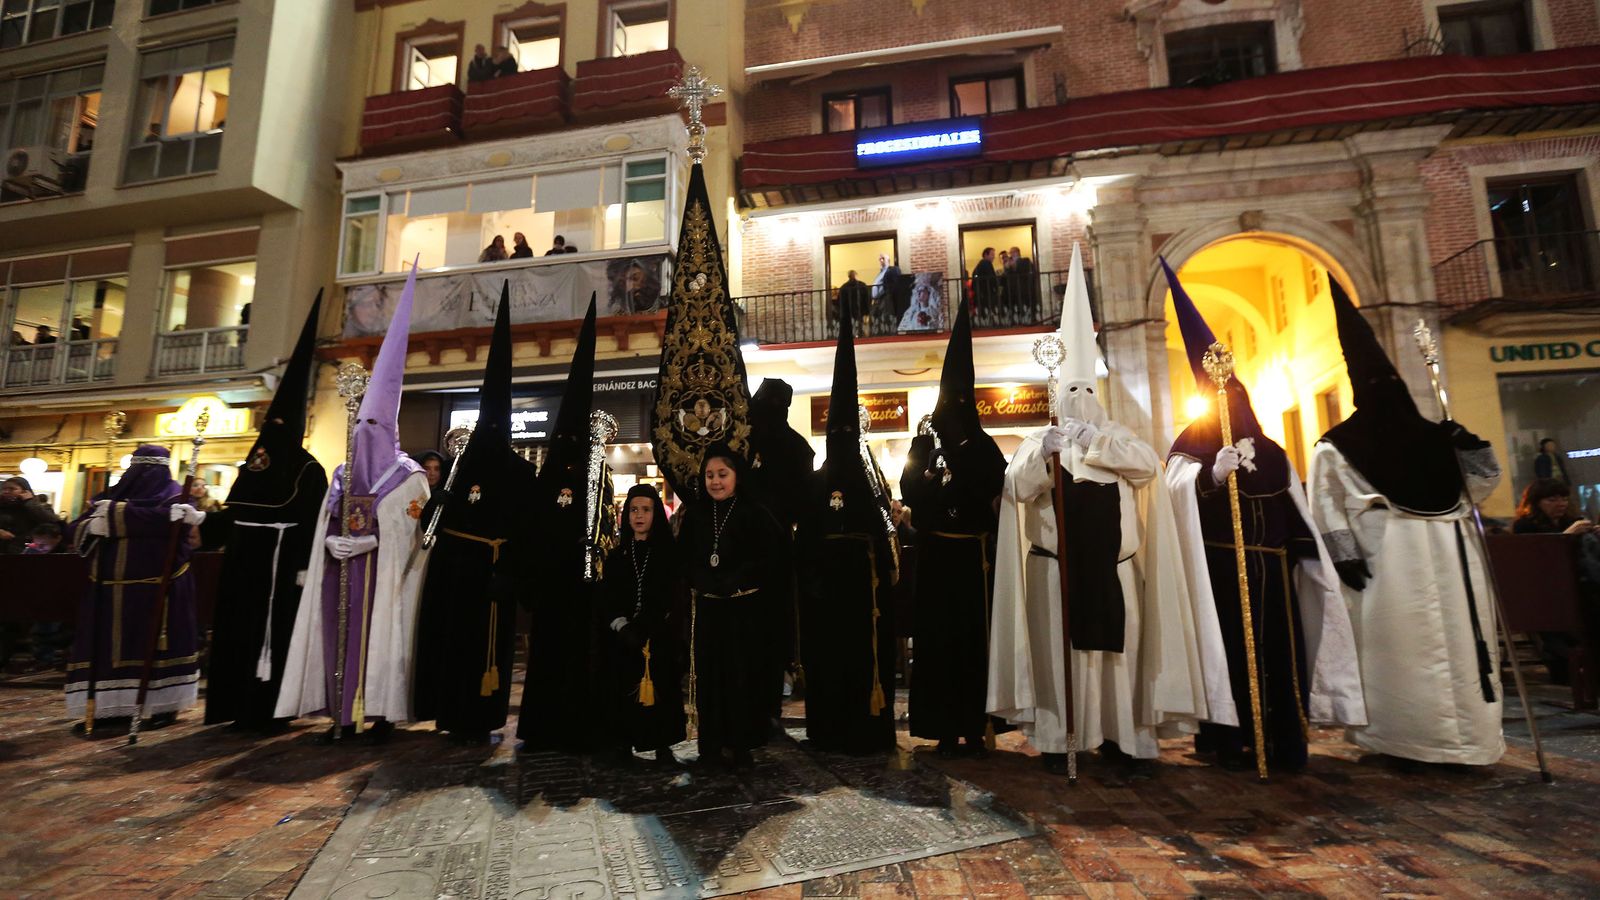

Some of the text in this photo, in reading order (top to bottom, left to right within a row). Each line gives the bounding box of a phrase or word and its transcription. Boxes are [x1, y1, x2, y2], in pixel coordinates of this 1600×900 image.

[1489, 341, 1582, 363] UNITED
[592, 379, 658, 392] ERNÁNDEZ BAC
[994, 398, 1050, 415] Canasta
